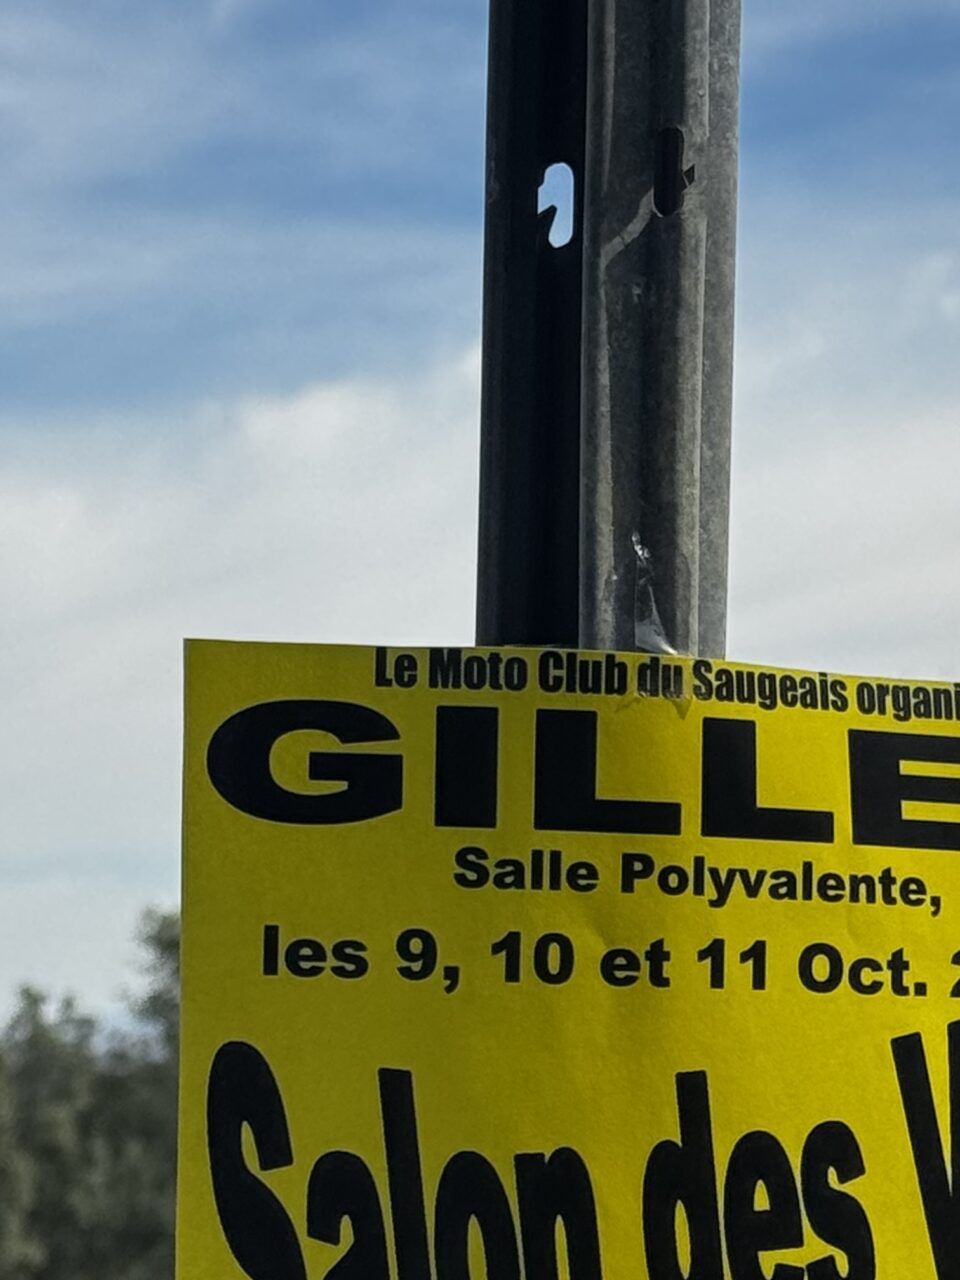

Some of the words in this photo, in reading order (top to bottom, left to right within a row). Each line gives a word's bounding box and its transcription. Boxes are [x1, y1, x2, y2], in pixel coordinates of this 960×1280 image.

[374, 646, 418, 689] Le
[427, 647, 529, 692] Moto
[537, 649, 628, 697] Club
[636, 656, 683, 699] du
[692, 659, 848, 712] Saugeais
[453, 845, 600, 891] Salle
[620, 852, 941, 916] Polyvalente,
[262, 924, 369, 979] les
[395, 928, 460, 995] 9,
[490, 930, 575, 985] 10
[599, 938, 671, 988] et
[697, 938, 766, 990] 11
[798, 942, 927, 996] Oct.
